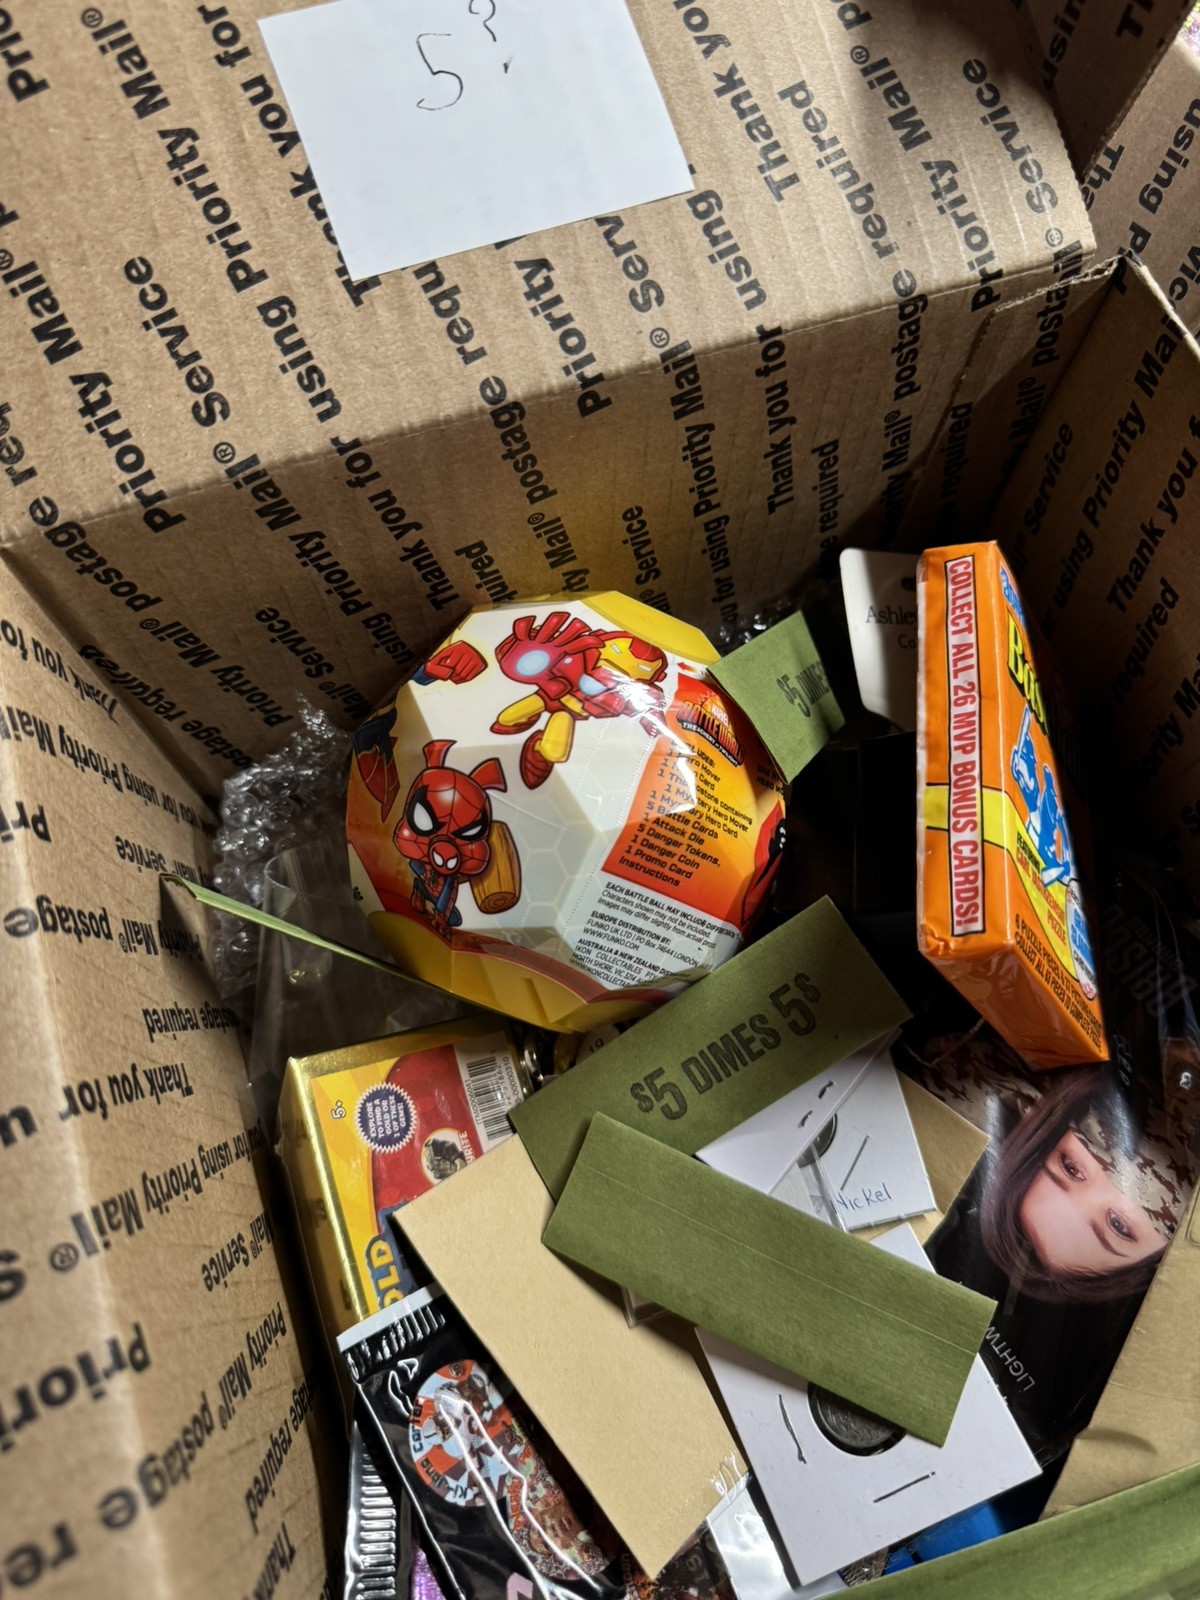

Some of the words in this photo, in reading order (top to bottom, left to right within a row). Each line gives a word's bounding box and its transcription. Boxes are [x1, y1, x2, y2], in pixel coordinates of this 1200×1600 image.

[196, 4, 252, 68] for
[672, 0, 732, 59] yo
[80, 7, 171, 120] Mail®
[240, 73, 302, 158] you
[850, 45, 932, 151] Mail®
[713, 62, 800, 203] Thank
[962, 58, 1058, 214] Service
[1139, 99, 1200, 214] using
[777, 80, 899, 259] required
[156, 126, 269, 293] Priority
[921, 159, 1003, 312] Priority
[594, 215, 665, 313] Serv
[686, 189, 767, 311] using
[124, 256, 231, 428] Service
[412, 261, 488, 366] requ
[514, 257, 613, 418] Priority
[890, 268, 929, 402] postage
[256, 295, 342, 424] using
[650, 327, 705, 421] Mail®
[755, 324, 788, 378] for
[765, 380, 797, 435] you
[68, 371, 187, 533] Priority
[330, 436, 382, 489] for
[479, 375, 558, 505] postage
[1082, 400, 1146, 529] Priority
[213, 442, 303, 532] Mail®
[682, 422, 721, 518] Priority
[763, 434, 795, 515] Thank
[811, 439, 844, 535] required
[1024, 423, 1073, 536] Service
[368, 488, 423, 541] you
[527, 512, 577, 569] Mail®
[1106, 517, 1165, 614] Thank
[1157, 447, 1198, 524] you
[29, 496, 164, 613] postage
[288, 530, 373, 617] Priority
[621, 505, 662, 585] Service
[701, 514, 732, 580] using
[399, 538, 460, 612] Thank
[949, 559, 974, 636] COLLECT
[31, 637, 69, 682] you
[255, 607, 334, 679] Service
[361, 612, 416, 667] using
[951, 641, 975, 680] ALL
[1110, 576, 1180, 702] required
[211, 664, 294, 728] Priority
[952, 681, 977, 709] 26
[58, 724, 124, 793] Priority
[181, 719, 254, 770] ostage
[953, 710, 977, 757] MVP
[121, 762, 159, 806] using
[698, 773, 716, 791] Card
[699, 764, 721, 783] Mover
[951, 759, 978, 834] BONUS
[646, 826, 685, 850] Danger
[652, 816, 687, 838] Attack
[688, 830, 705, 845] Die
[657, 804, 691, 826] Battle
[691, 821, 719, 840] Cards
[704, 815, 722, 832] Hero
[722, 824, 739, 839] Card
[712, 804, 730, 821] Hero
[729, 815, 749, 833] Mover
[719, 799, 753, 826] containing
[115, 836, 167, 873] Service
[619, 856, 681, 888] Instructions
[634, 847, 669, 869] Promo
[668, 861, 694, 880] Card
[640, 837, 678, 862] Danger
[675, 853, 700, 870] Coin
[951, 838, 980, 928] CARDS!
[4, 894, 113, 943] postage
[586, 918, 612, 935] FUNKO
[611, 926, 621, 937] UK
[620, 930, 633, 941] LTD
[635, 935, 646, 946] PO
[591, 910, 618, 926] EUROPE
[617, 919, 662, 942] DISTRIBUTION
[597, 896, 621, 913] Images
[620, 905, 634, 918] may
[634, 909, 651, 922] differ
[650, 915, 673, 934] slightly
[672, 925, 687, 938] from
[601, 889, 635, 908] Characters
[634, 900, 655, 914] shown
[654, 908, 669, 922] may
[668, 914, 681, 926] not
[605, 881, 625, 895] EACH
[624, 888, 651, 904] BATTLE
[650, 898, 666, 911] BALL
[666, 905, 681, 917] MAY
[680, 910, 706, 928] INCLUDE
[575, 944, 593, 957] IKON
[595, 950, 644, 974] COLLECTABLES
[577, 937, 614, 956] AUSTRALIA
[618, 950, 634, 963] NEW
[633, 955, 660, 973] ZEALAND
[582, 926, 641, 952] WWW.FUNKO.COM
[1014, 931, 1036, 970] COLLECT
[1021, 919, 1044, 957] PUZZLE
[142, 1001, 200, 1043] required
[629, 1066, 689, 1121] $5
[680, 1012, 783, 1096] DIMES
[768, 971, 822, 1037] 5$
[60, 1079, 109, 1121] for
[107, 1063, 145, 1105] you
[143, 1063, 194, 1105] Thank
[331, 1099, 348, 1120] 5+
[389, 1094, 397, 1120] THESE
[368, 1101, 378, 1138] EXPLORE
[375, 1104, 383, 1127] FIND
[141, 1158, 203, 1215] Priority
[198, 1145, 233, 1180] using
[202, 1232, 250, 1293] Service
[248, 1301, 288, 1370] Priority
[985, 1325, 1036, 1392] LIGHTW
[98, 1390, 216, 1531] postage
[245, 1417, 293, 1535] required
